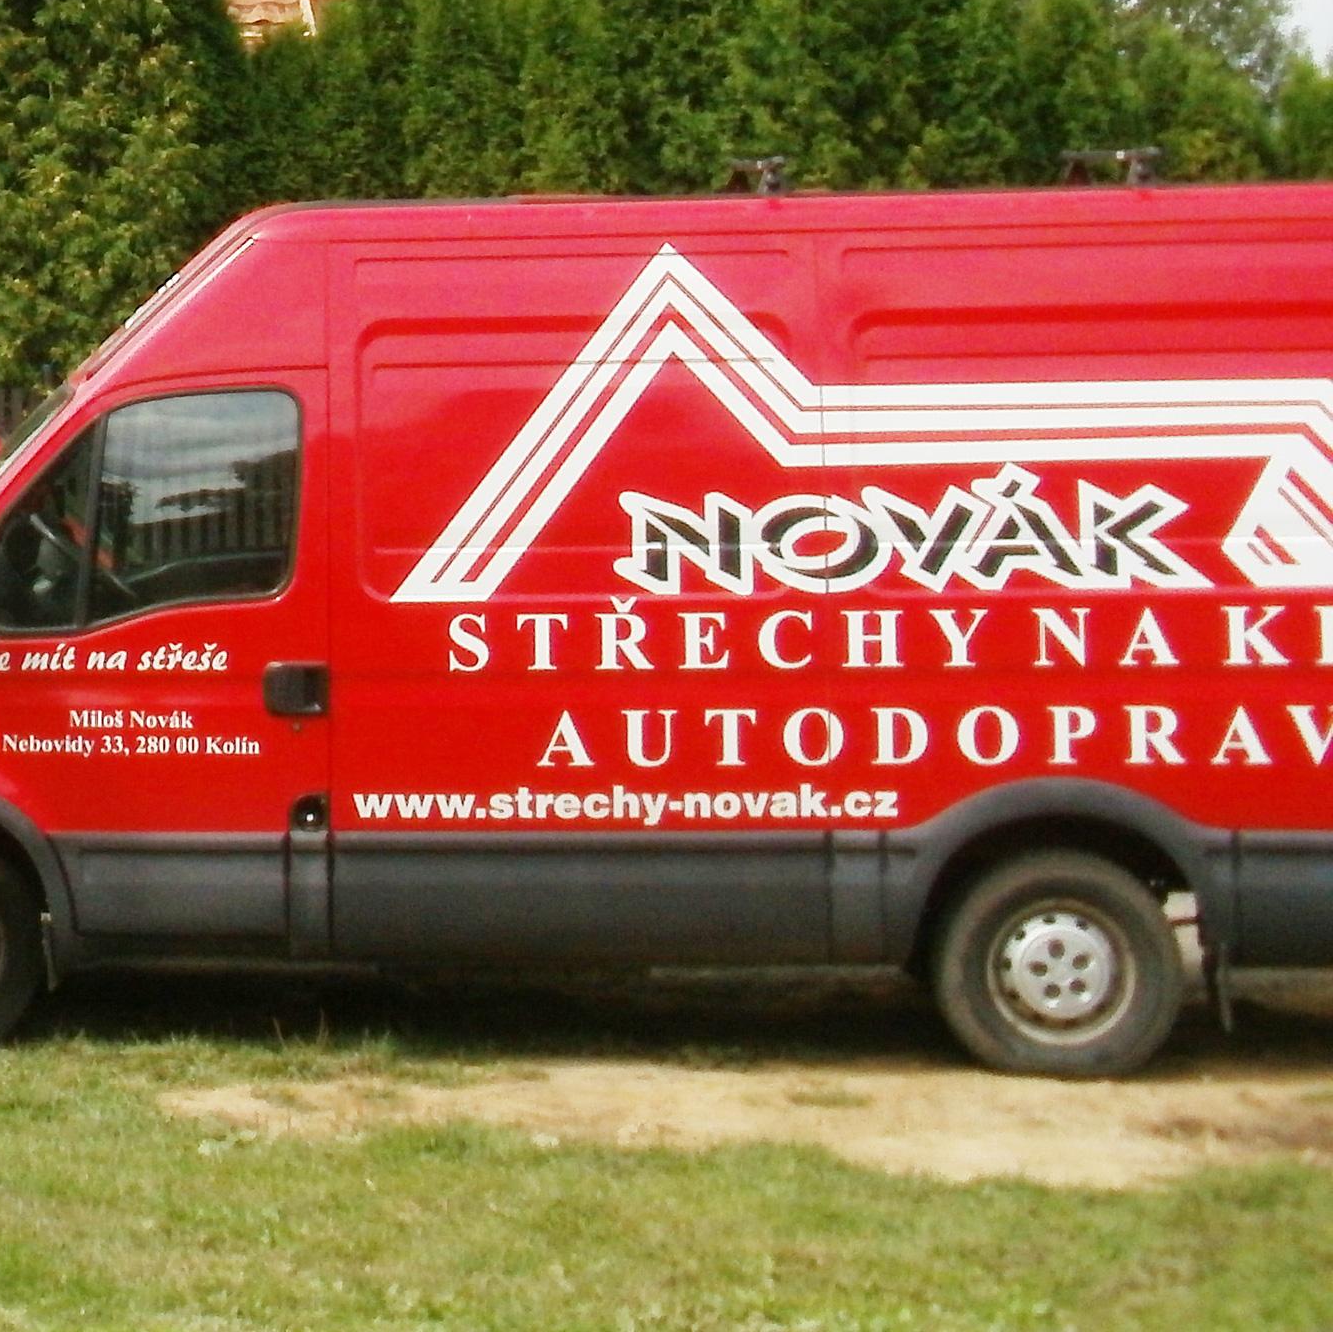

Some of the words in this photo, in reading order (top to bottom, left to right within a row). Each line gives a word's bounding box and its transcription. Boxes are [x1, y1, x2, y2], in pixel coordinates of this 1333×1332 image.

[612, 462, 1216, 595] NOVÁK
[447, 596, 989, 672] STŘECHY
[1031, 605, 1181, 668] NA
[21, 643, 77, 672] mít
[87, 650, 127, 672] na
[136, 642, 228, 672] střeše
[68, 709, 124, 728] Miloš
[129, 709, 194, 728] Novák
[537, 704, 1333, 767] AUTODOPRAV
[1, 734, 95, 758] Nebovidy
[100, 735, 130, 757] 33,
[136, 736, 170, 755] 280
[175, 736, 200, 755] 00
[205, 735, 261, 756] Kolín
[353, 785, 899, 826] www.strechy-novak.cz
